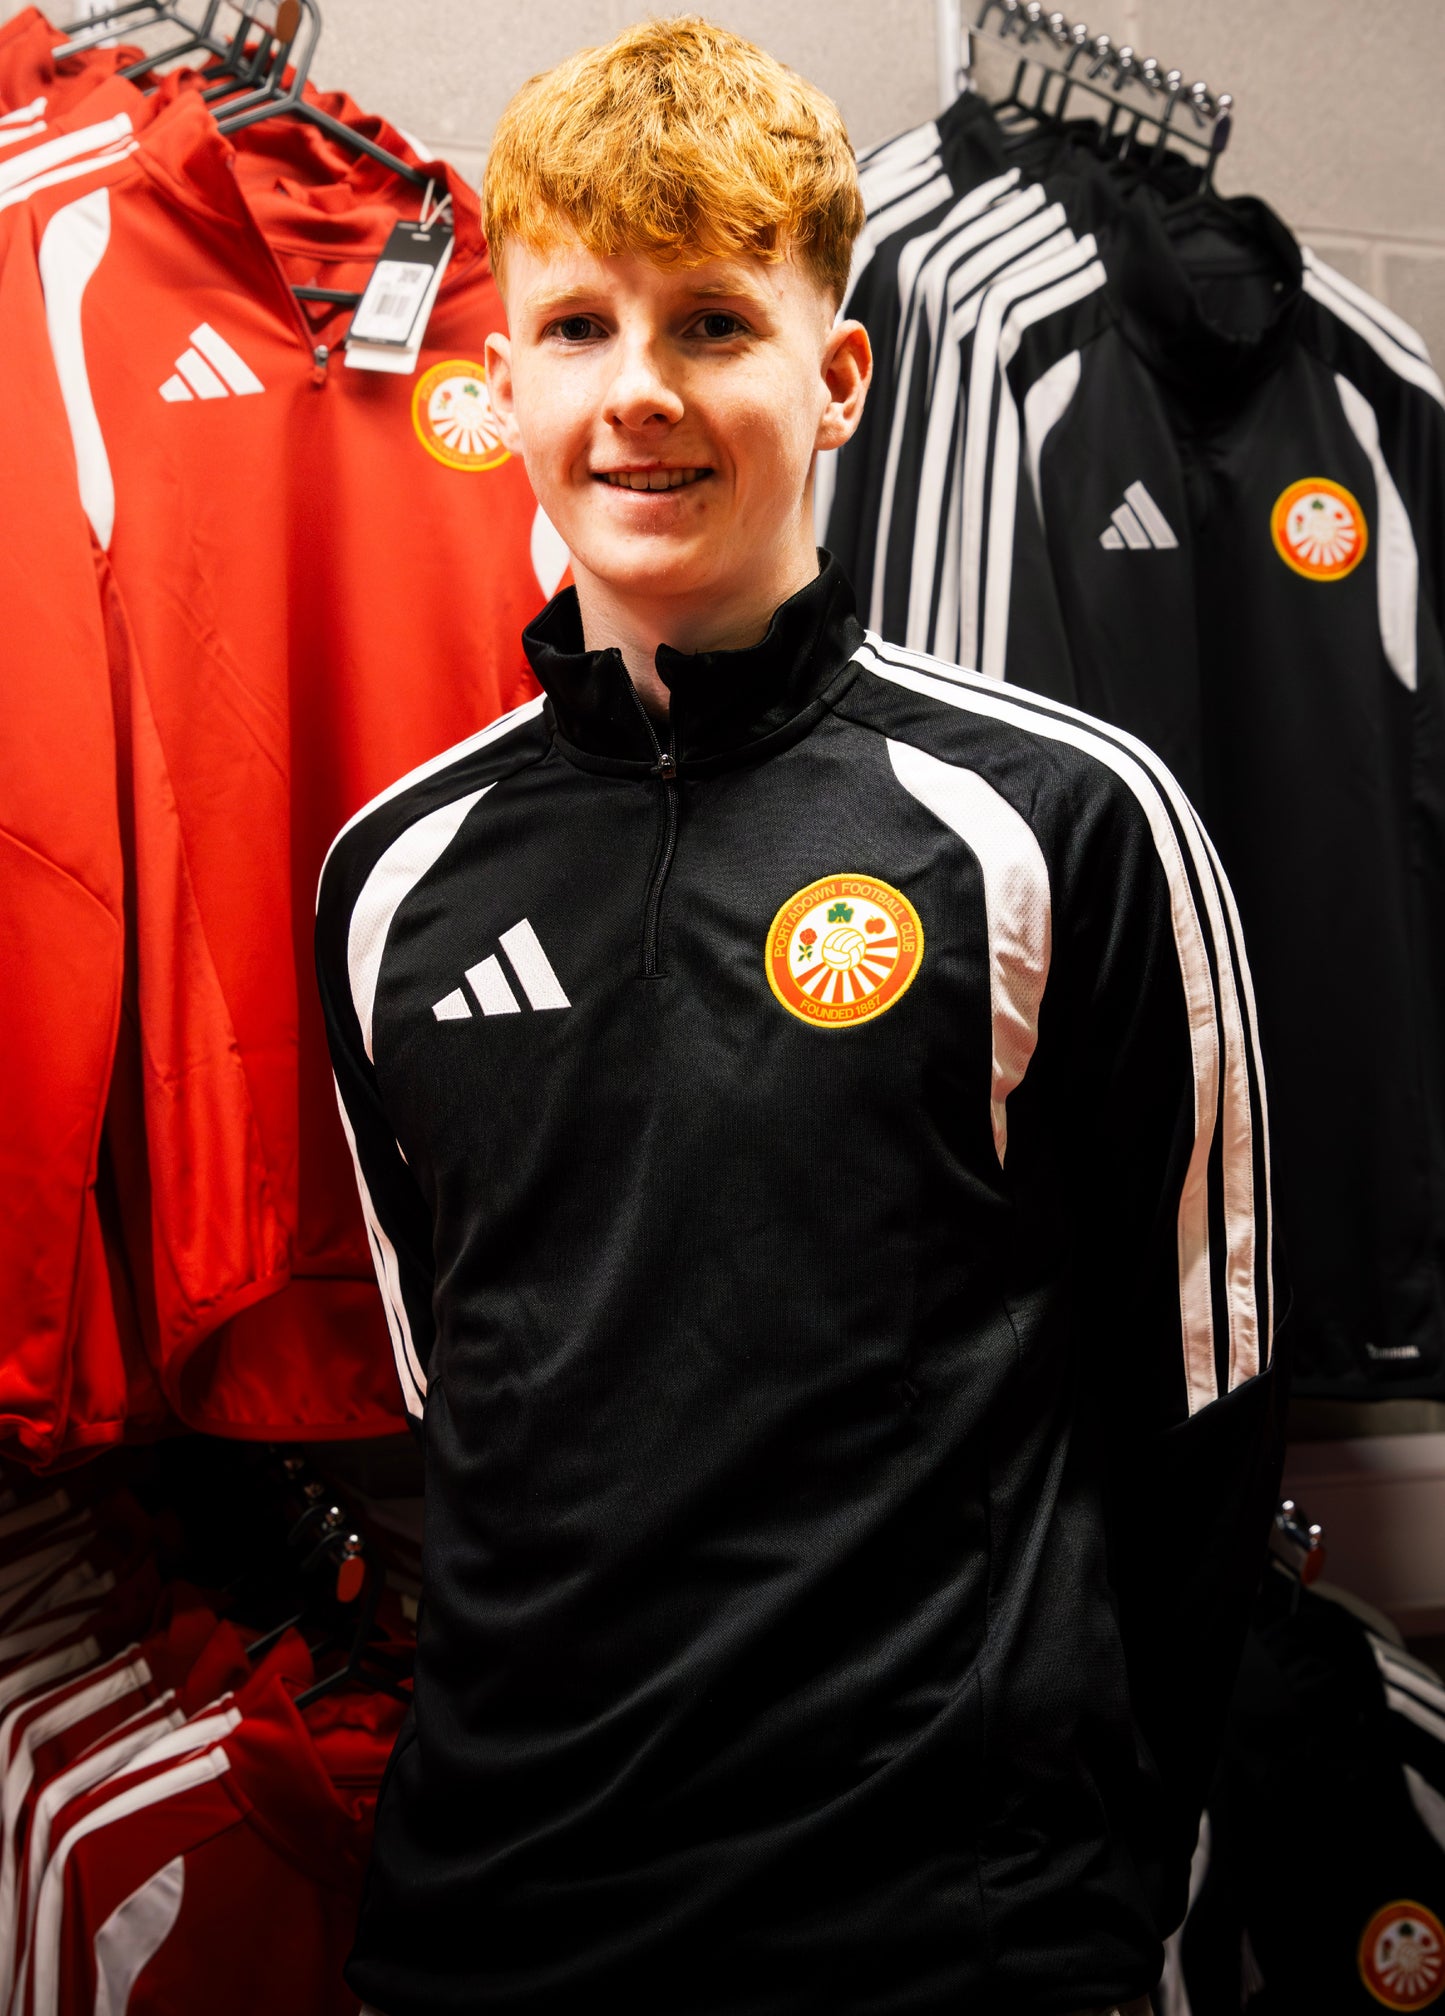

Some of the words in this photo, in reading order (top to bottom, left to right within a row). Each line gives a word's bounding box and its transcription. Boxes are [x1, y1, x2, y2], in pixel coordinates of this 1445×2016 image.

[774, 884, 836, 958] PORTADOWN
[841, 882, 905, 921] FOOTBALL
[900, 921, 916, 953] CLUB
[800, 1000, 854, 1020] FOUNDED
[856, 994, 881, 1015] 1887
